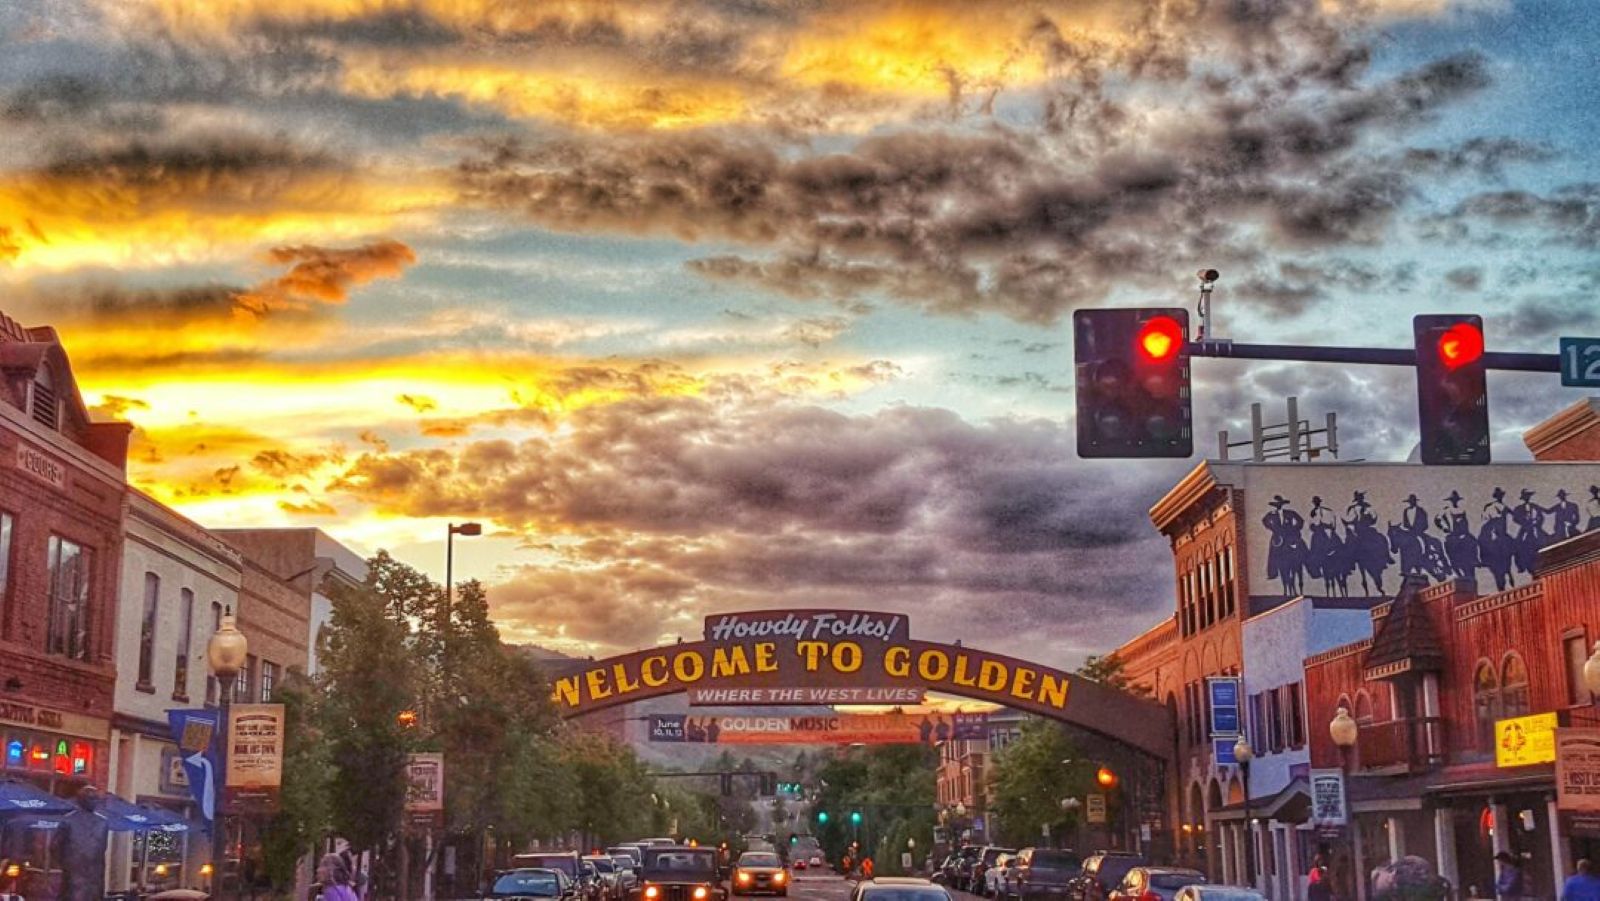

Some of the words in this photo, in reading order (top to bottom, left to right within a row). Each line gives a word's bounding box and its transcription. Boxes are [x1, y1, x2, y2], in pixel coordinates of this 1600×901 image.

[712, 613, 809, 640] Howdy
[810, 613, 899, 641] Folks!
[550, 642, 778, 706] WELCOME
[797, 641, 863, 673] TO
[884, 646, 1070, 709] GOLDEN
[697, 689, 762, 701] WHERE
[768, 689, 803, 701] THE
[809, 688, 862, 700] WEST
[866, 688, 918, 700] LIVES
[658, 719, 680, 728] June
